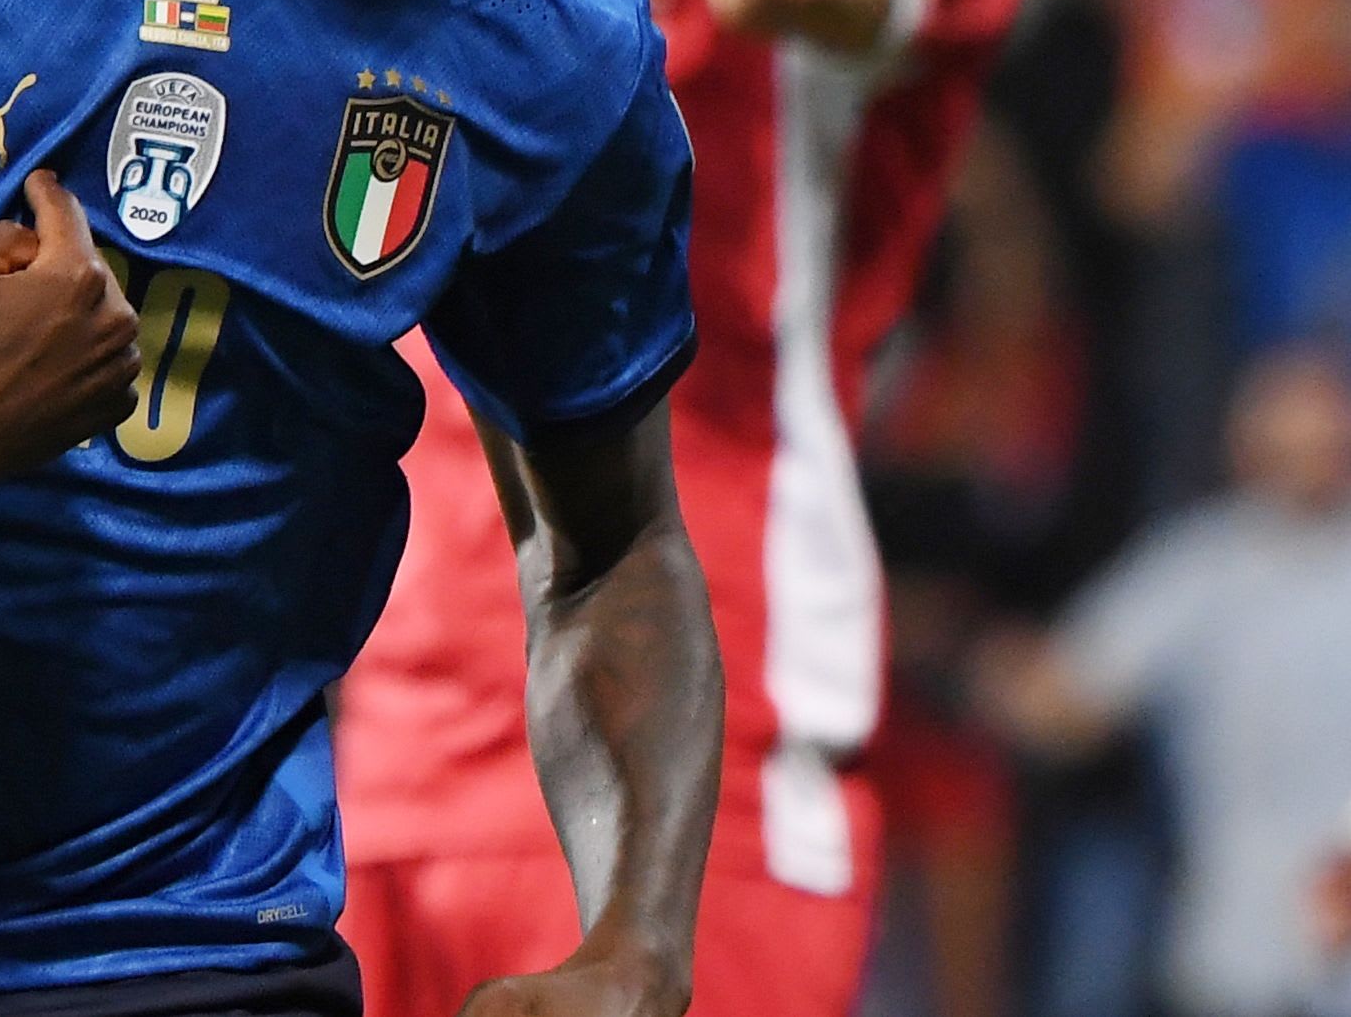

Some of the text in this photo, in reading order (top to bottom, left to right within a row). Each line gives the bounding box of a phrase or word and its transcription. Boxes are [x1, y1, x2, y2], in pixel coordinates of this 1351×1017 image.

[154, 82, 197, 102] UEFA
[136, 101, 211, 124] EUROPEAN
[132, 115, 206, 137] CHAMPIONS
[352, 111, 439, 148] ITALIA
[129, 205, 168, 224] 2020
[257, 903, 309, 924] DRYCELL
